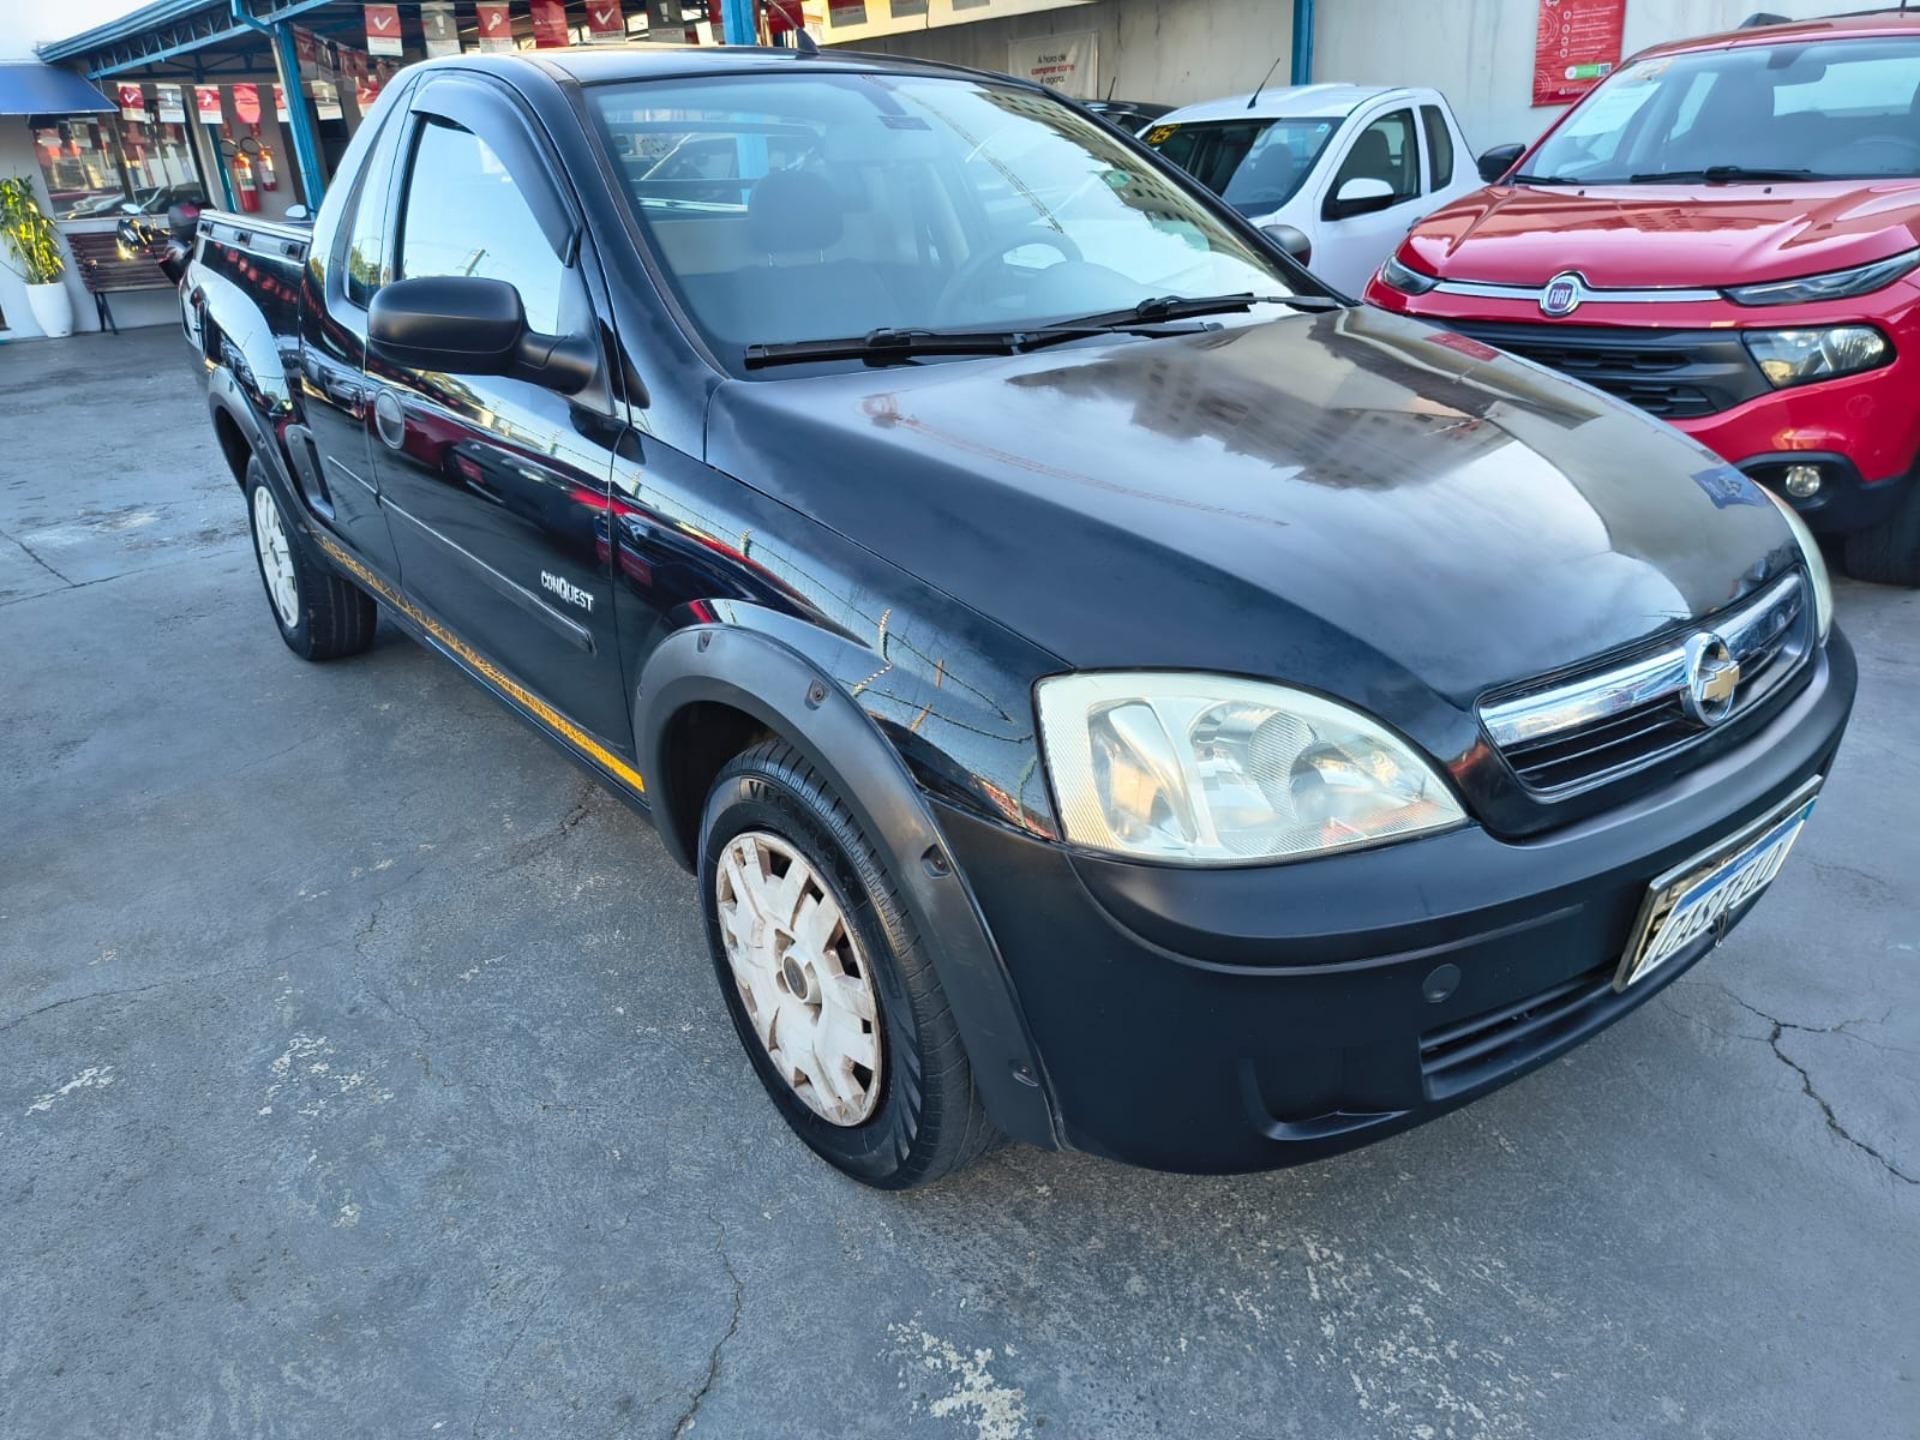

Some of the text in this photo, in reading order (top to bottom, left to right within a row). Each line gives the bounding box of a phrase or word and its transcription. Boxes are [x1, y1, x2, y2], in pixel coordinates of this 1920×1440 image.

[1043, 55, 1057, 63] hora
[1058, 54, 1066, 62] de
[1549, 289, 1571, 305] FIAT
[540, 569, 594, 612] CONQUEST
[1655, 841, 1784, 963] CASTELO
